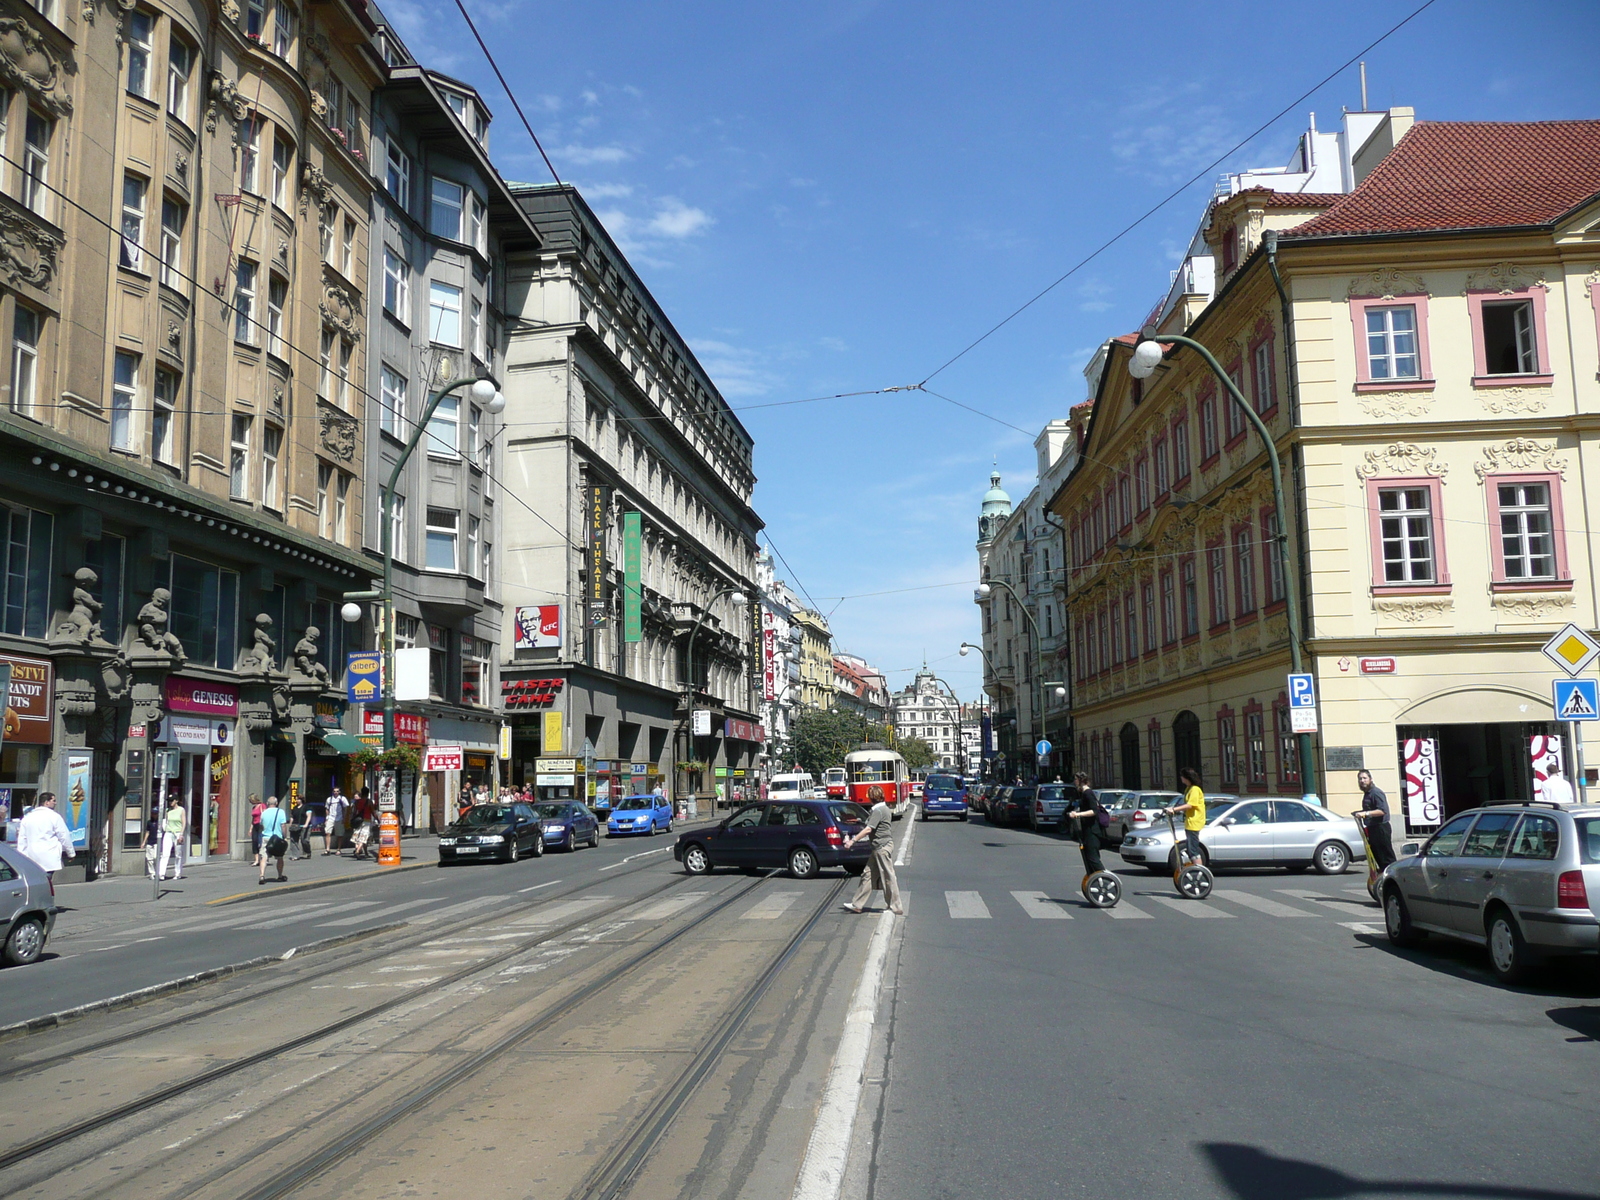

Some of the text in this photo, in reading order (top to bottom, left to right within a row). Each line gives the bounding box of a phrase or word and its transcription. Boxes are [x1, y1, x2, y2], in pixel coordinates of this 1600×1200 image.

[542, 621, 557, 632] KFC
[352, 661, 376, 670] albert
[501, 678, 564, 690] LASER
[1293, 678, 1308, 698] P
[193, 690, 234, 707] GENESIS
[505, 693, 556, 704] GAME
[1419, 740, 1439, 821] café
